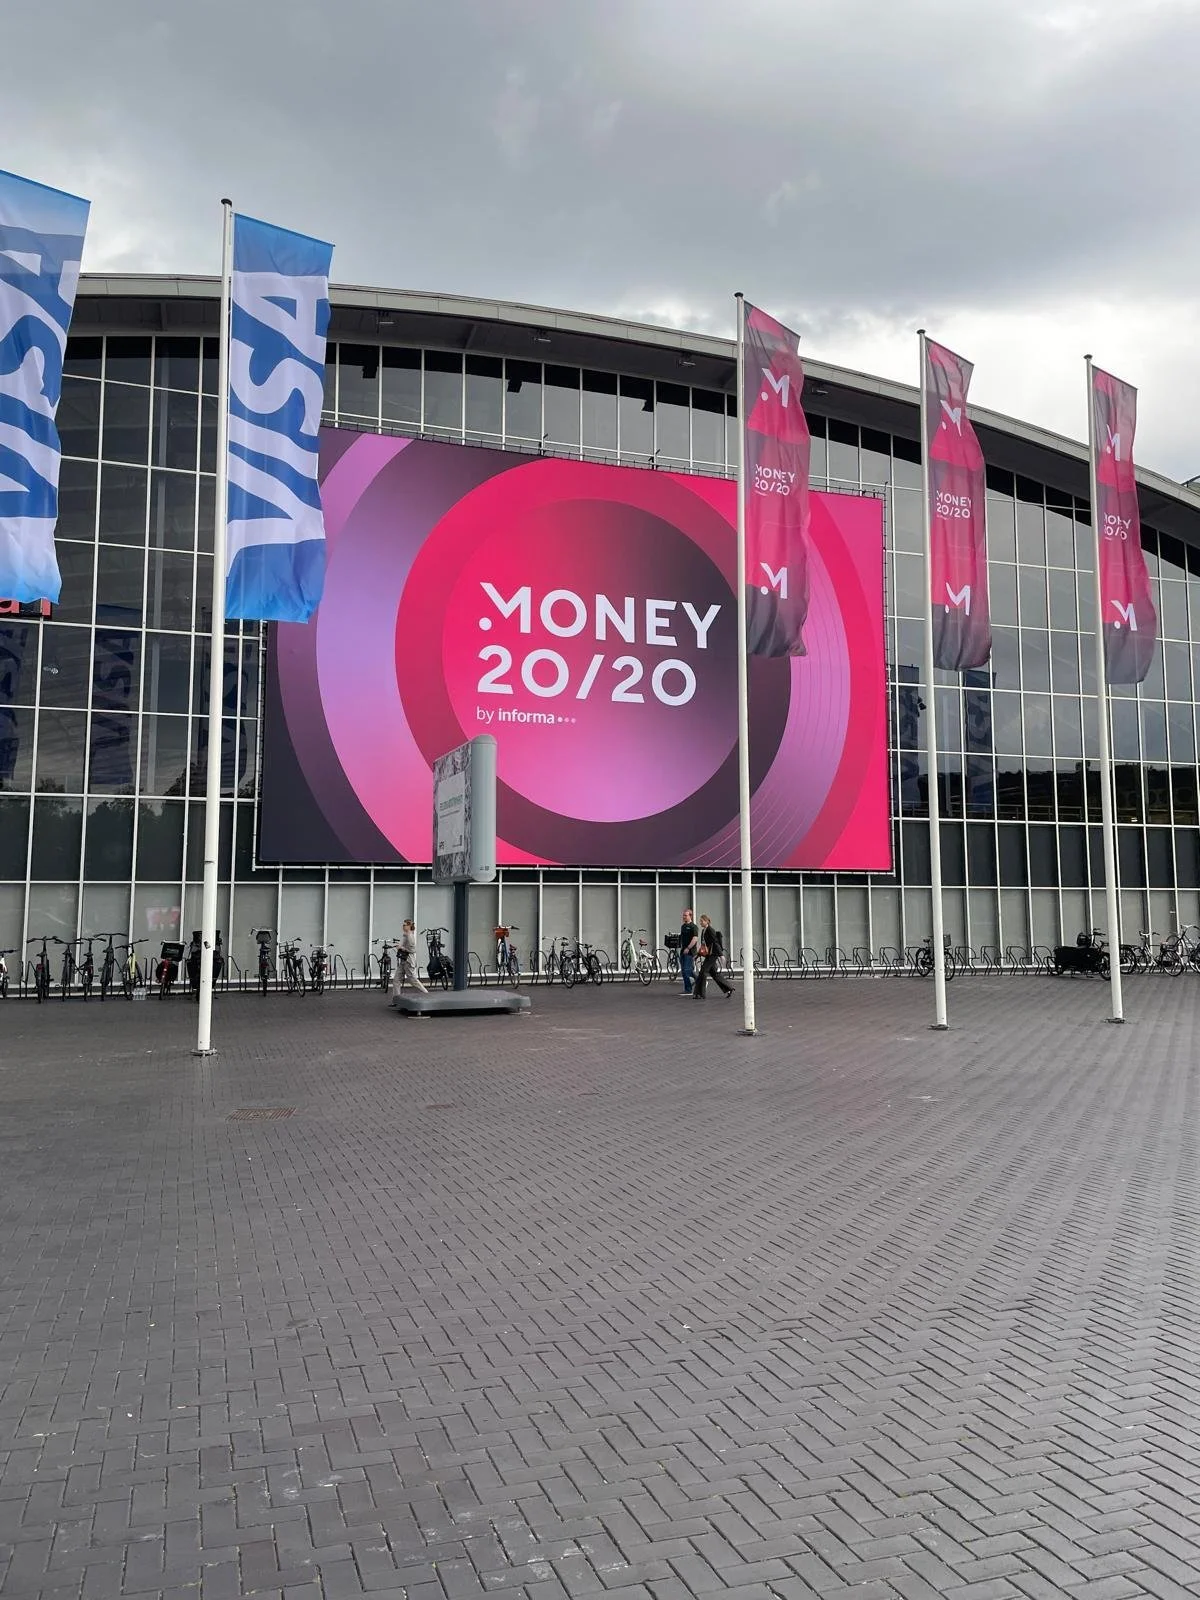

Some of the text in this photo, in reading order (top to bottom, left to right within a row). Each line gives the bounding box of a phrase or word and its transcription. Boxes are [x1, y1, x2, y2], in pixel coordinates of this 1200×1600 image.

[226, 271, 329, 577] VISA
[755, 463, 795, 483] MONEY
[755, 477, 790, 496] 20/20
[936, 490, 972, 509] MONEY
[936, 503, 971, 519] 20/20
[478, 582, 722, 649] MONEY
[477, 645, 697, 707] 20/20
[476, 706, 495, 724] by
